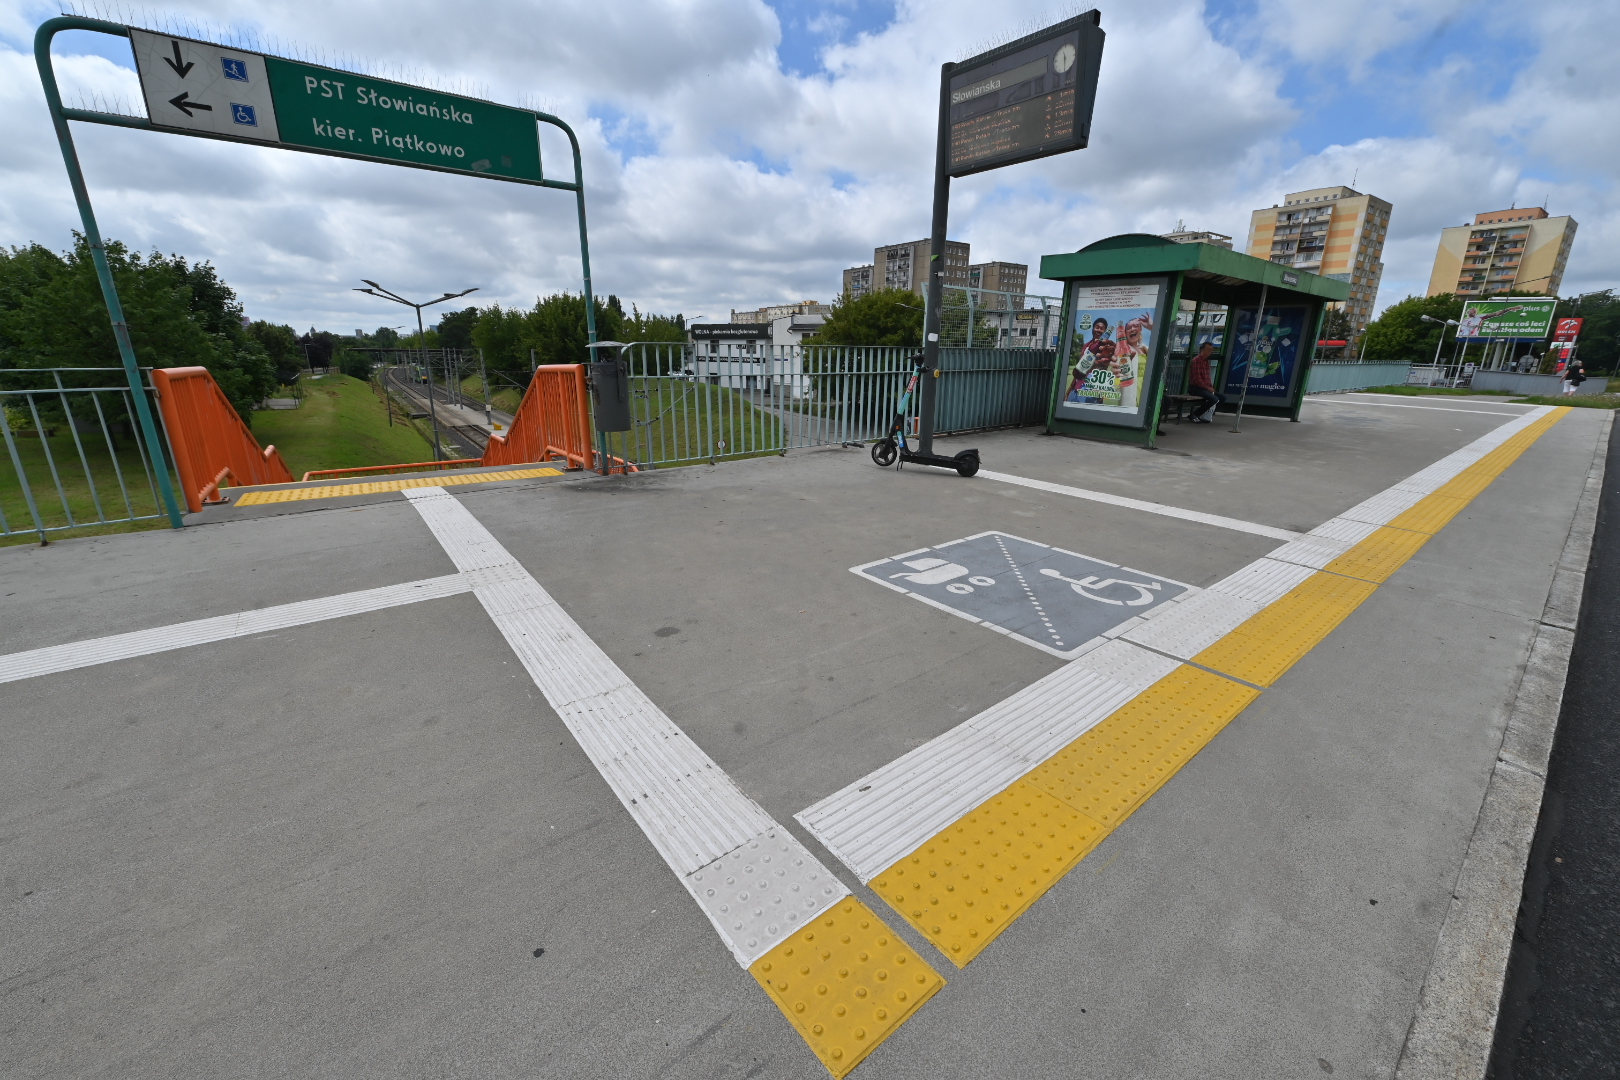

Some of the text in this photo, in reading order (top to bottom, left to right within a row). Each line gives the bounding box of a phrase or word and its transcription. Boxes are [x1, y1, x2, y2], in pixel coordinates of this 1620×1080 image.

[304, 76, 473, 125] PST Słowiańska
[312, 117, 466, 158] kier. Piątkowo
[1090, 369, 1115, 386] 30%
